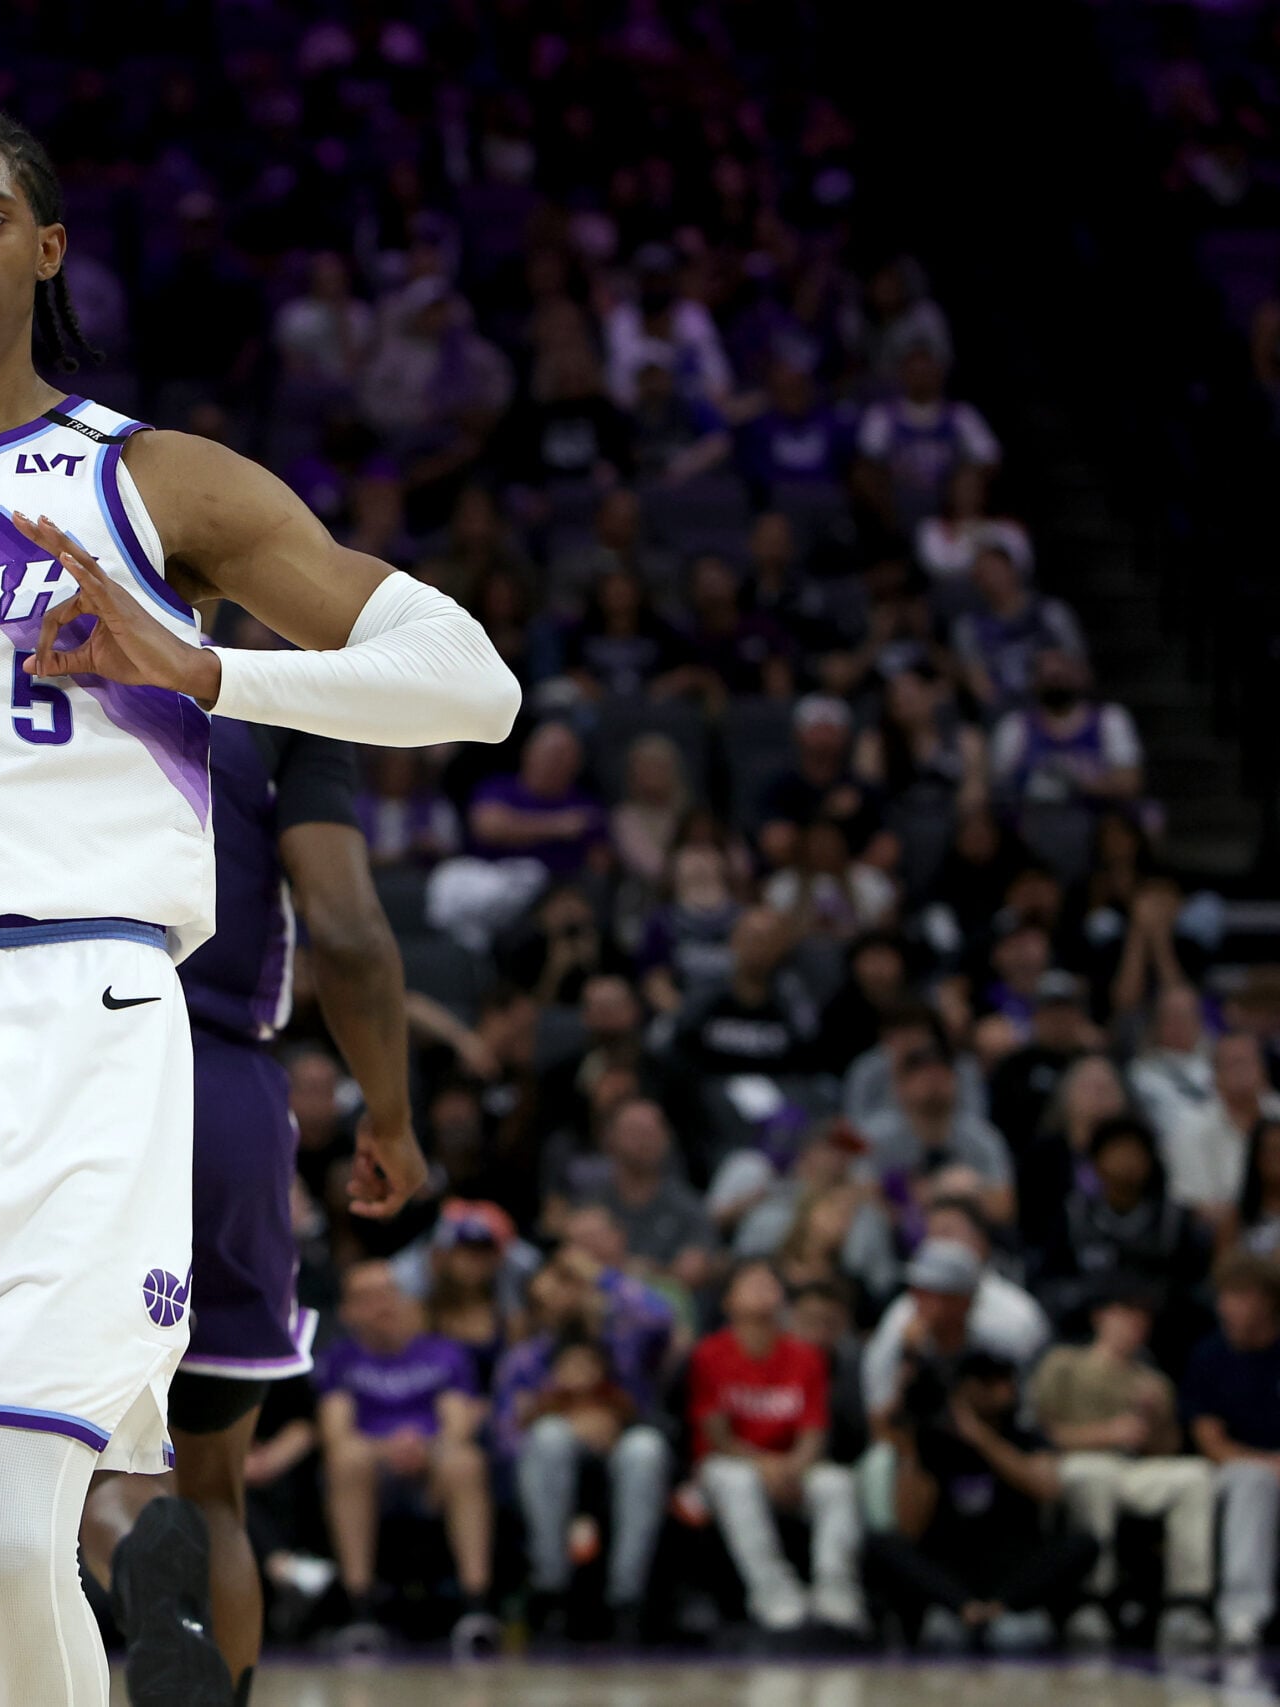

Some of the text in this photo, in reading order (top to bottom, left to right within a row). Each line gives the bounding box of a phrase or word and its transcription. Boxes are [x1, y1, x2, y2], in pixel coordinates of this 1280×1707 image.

[66, 420, 105, 441] FRANK
[15, 453, 87, 477] LVT
[11, 648, 74, 746] 5
